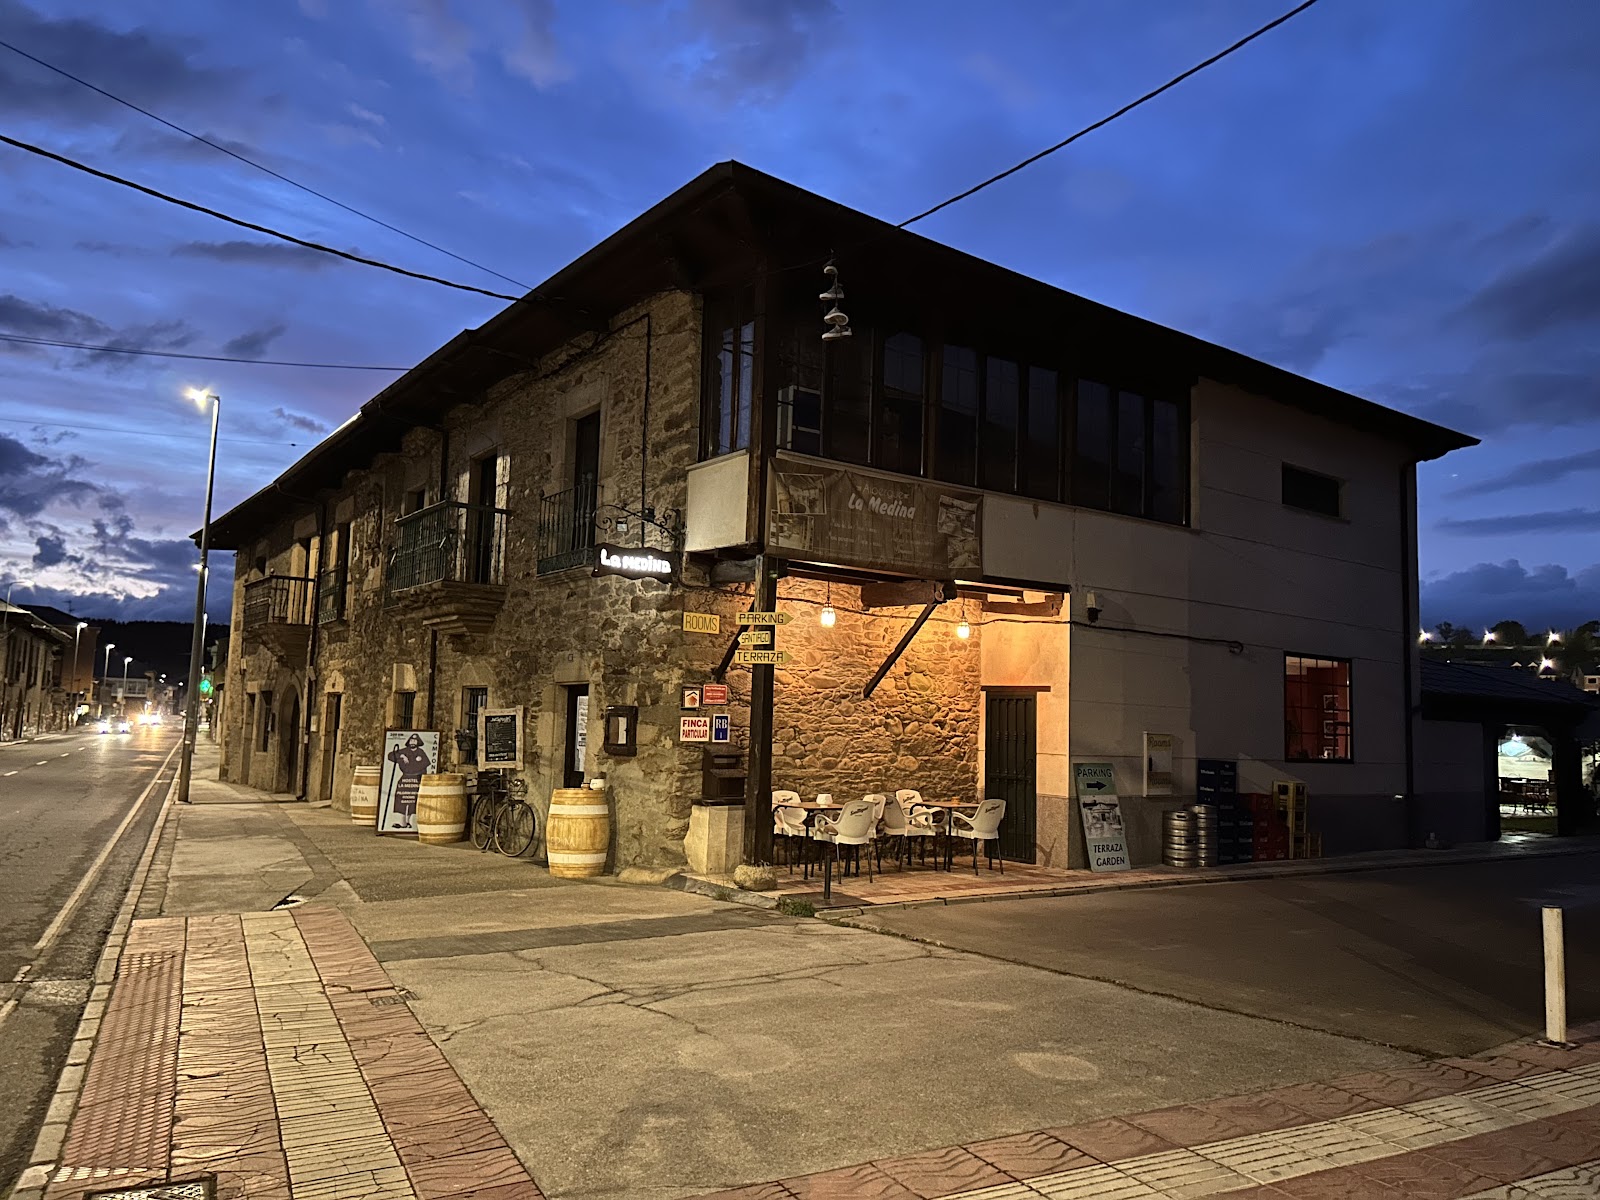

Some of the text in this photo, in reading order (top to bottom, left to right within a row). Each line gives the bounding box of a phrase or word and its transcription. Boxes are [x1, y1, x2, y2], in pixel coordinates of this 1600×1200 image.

[848, 492, 916, 519] La Medina
[600, 548, 621, 568] La
[685, 614, 718, 632] ROOMS
[738, 613, 784, 624] PARKING
[741, 632, 769, 644] SANTIAGO
[736, 651, 784, 662] TERRAZA
[682, 719, 708, 728] FINCA
[715, 718, 728, 729] RB
[682, 729, 708, 739] PARTICULAR
[1077, 768, 1112, 778] PARKING
[1093, 843, 1123, 853] TERRAZA
[1096, 856, 1125, 867] GARDEN
